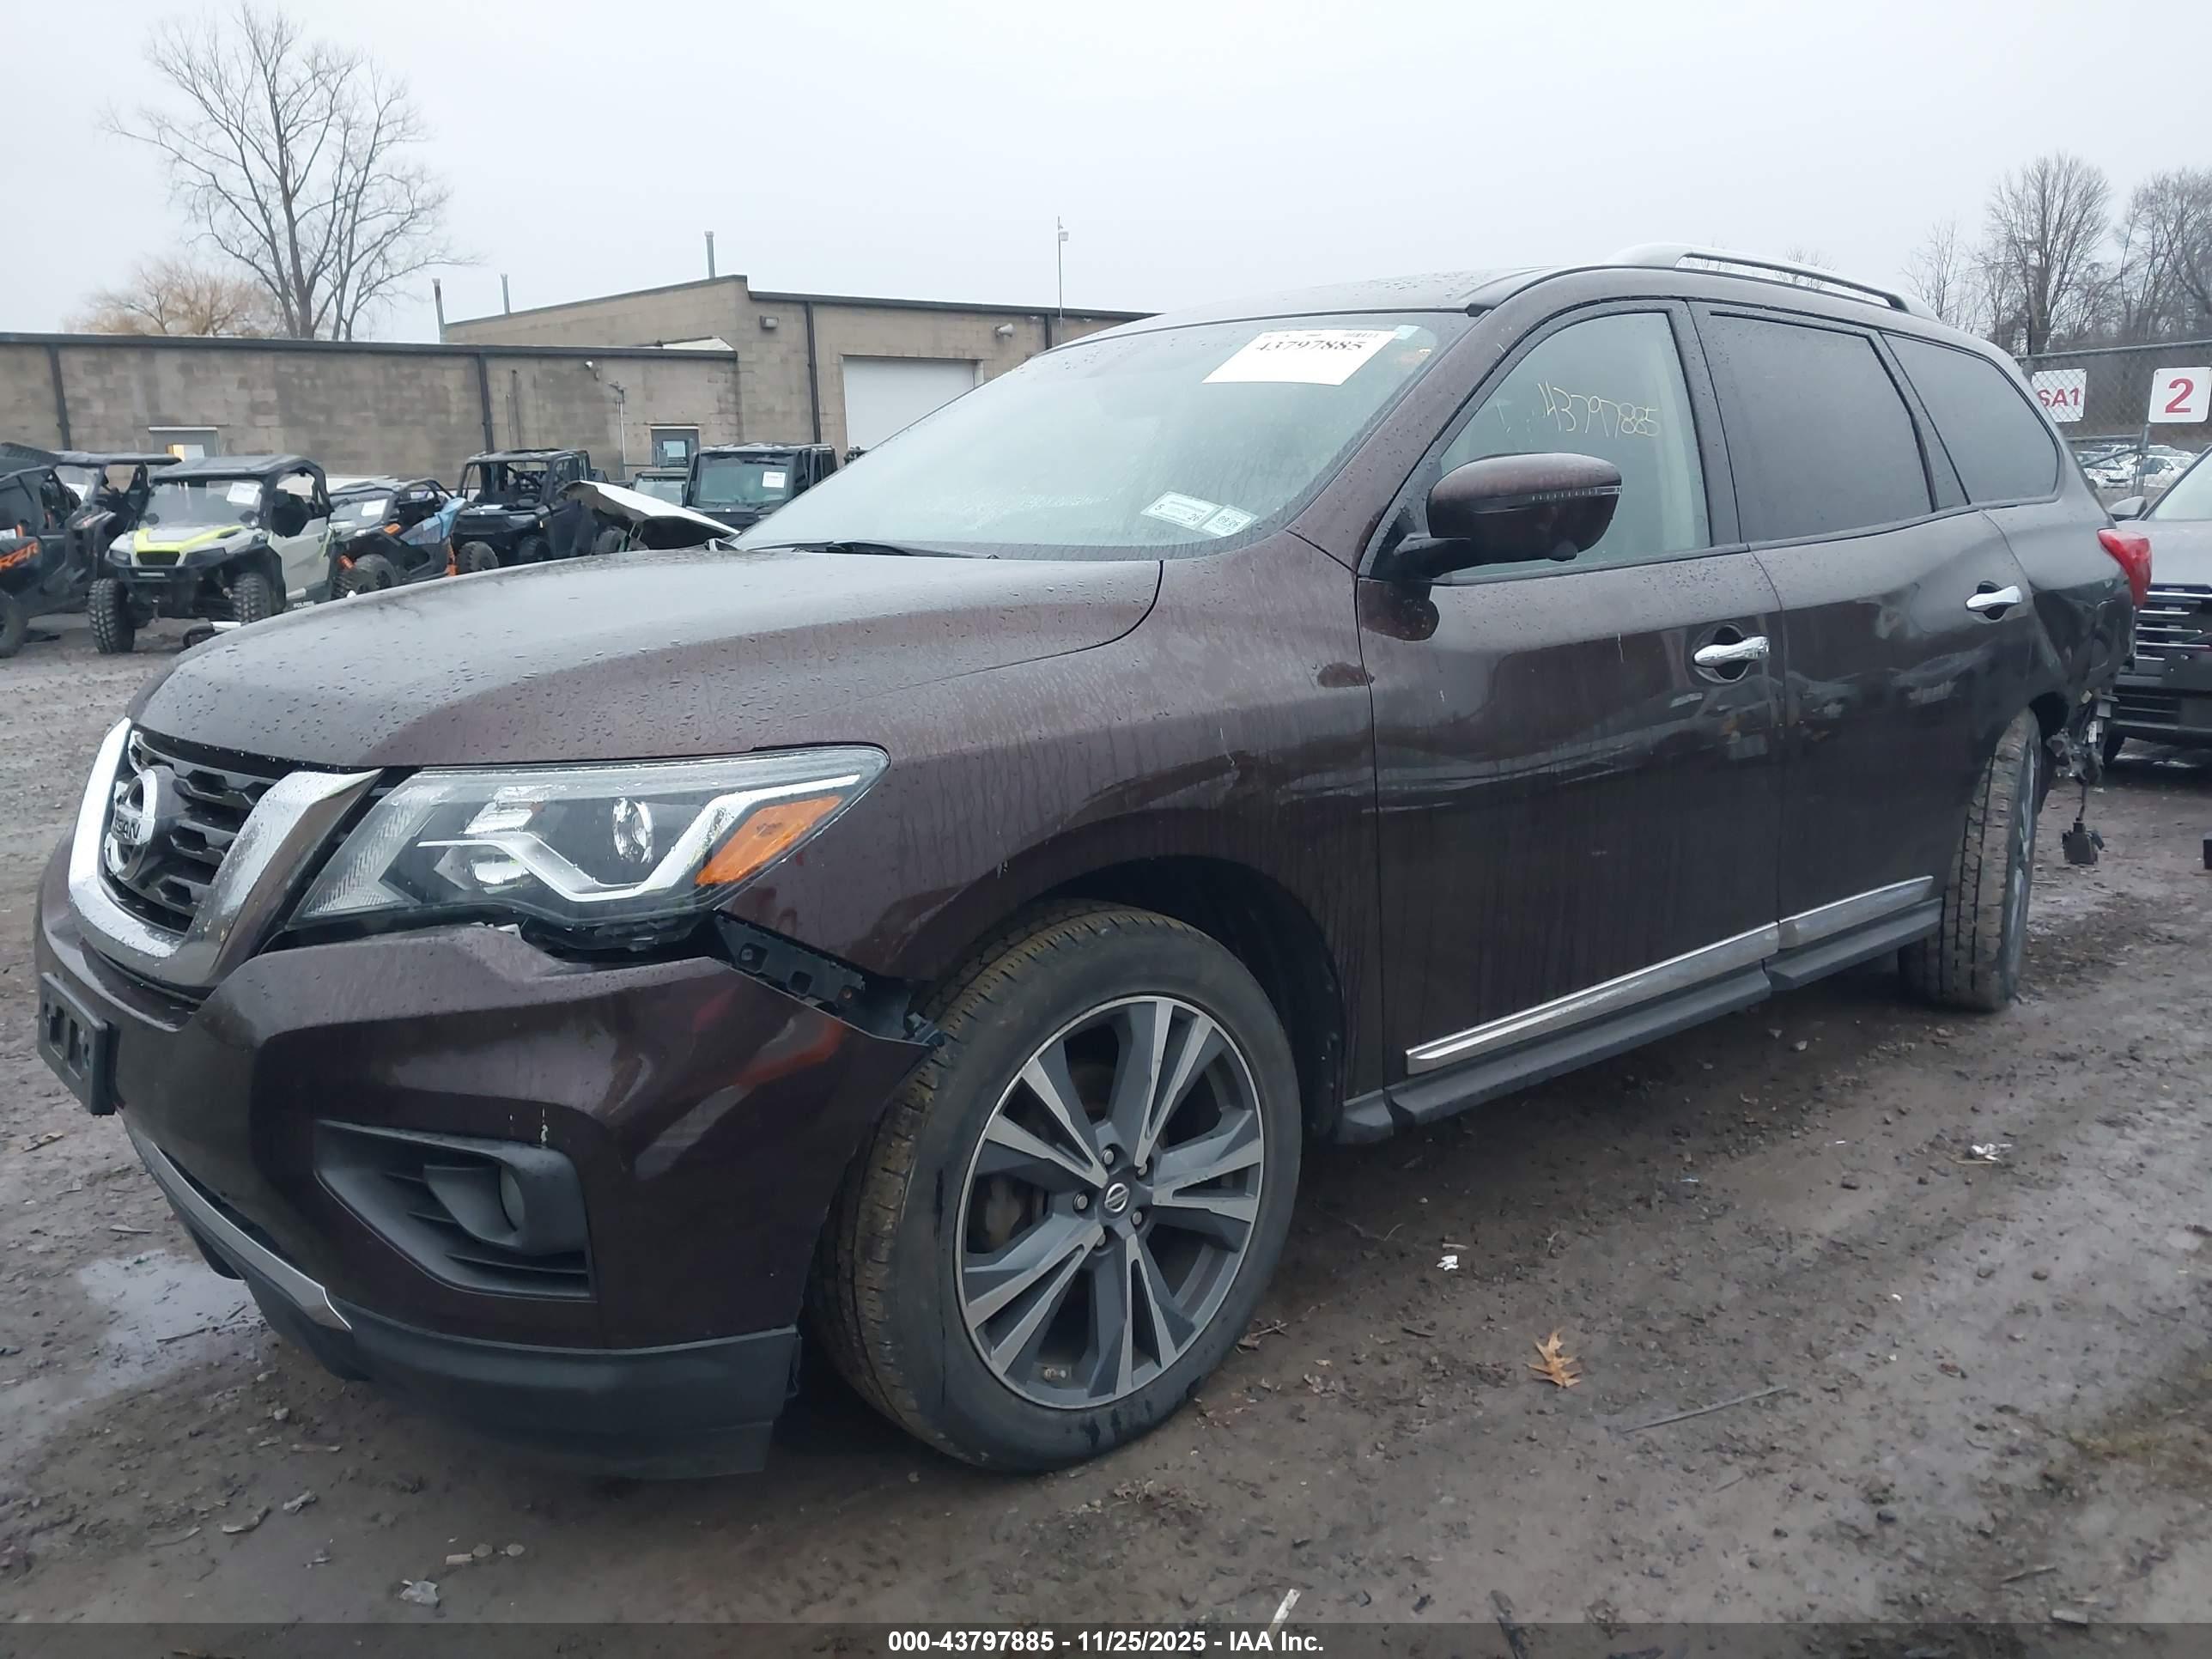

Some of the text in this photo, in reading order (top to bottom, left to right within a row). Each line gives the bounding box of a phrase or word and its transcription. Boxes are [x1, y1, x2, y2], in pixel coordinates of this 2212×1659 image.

[1256, 340, 1367, 350] 43797885
[1537, 380, 1662, 438] 43797885
[2038, 387, 2080, 407] SA1
[2165, 378, 2194, 413] 2
